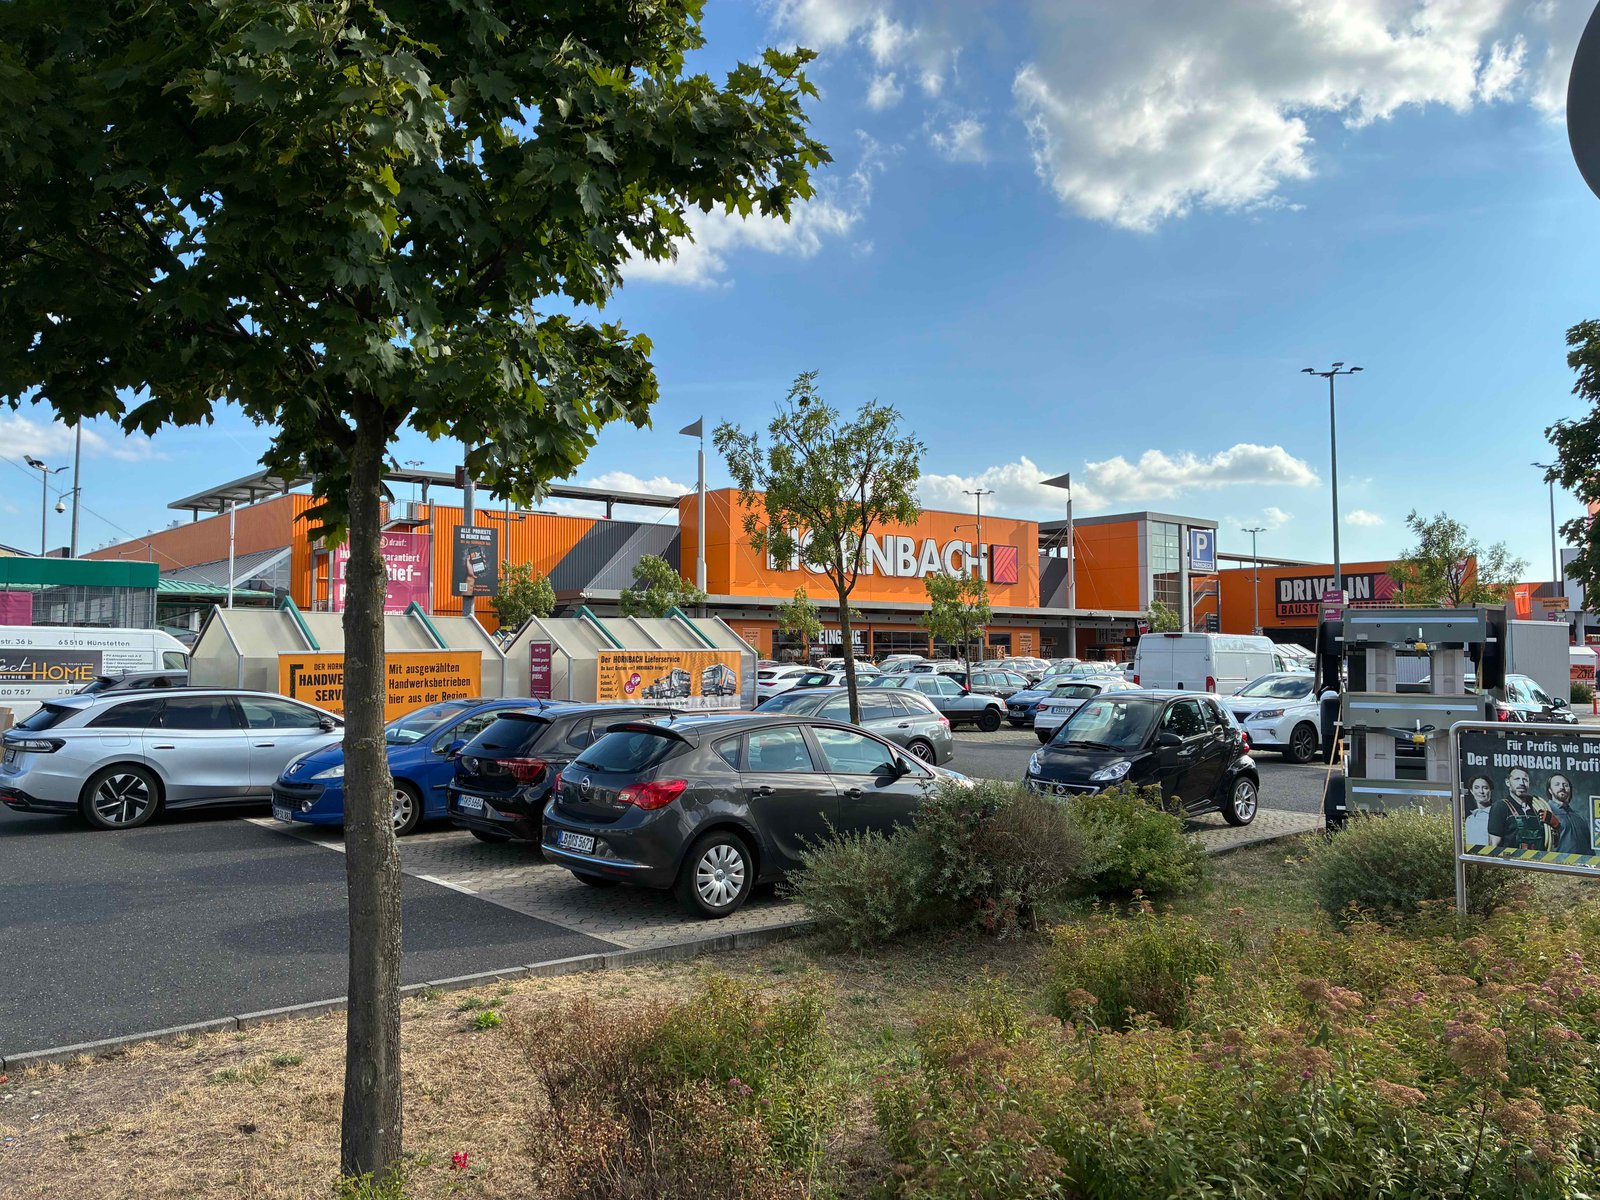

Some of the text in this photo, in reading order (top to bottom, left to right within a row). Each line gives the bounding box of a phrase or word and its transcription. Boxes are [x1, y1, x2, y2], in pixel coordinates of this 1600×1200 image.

[766, 525, 988, 582] HORNBACH
[1196, 533, 1208, 559] P
[32, 662, 94, 680] HOME
[389, 664, 460, 674] Mit ausgewählten
[389, 678, 470, 689] Handwerksbetrieben
[389, 694, 404, 704] hier
[408, 694, 422, 703] aus
[425, 692, 437, 702] der
[1507, 740, 1522, 751] Für
[1527, 740, 1557, 752] Profis
[1562, 742, 1579, 753] wie
[1467, 752, 1600, 772] Der HORNBACH Profi
